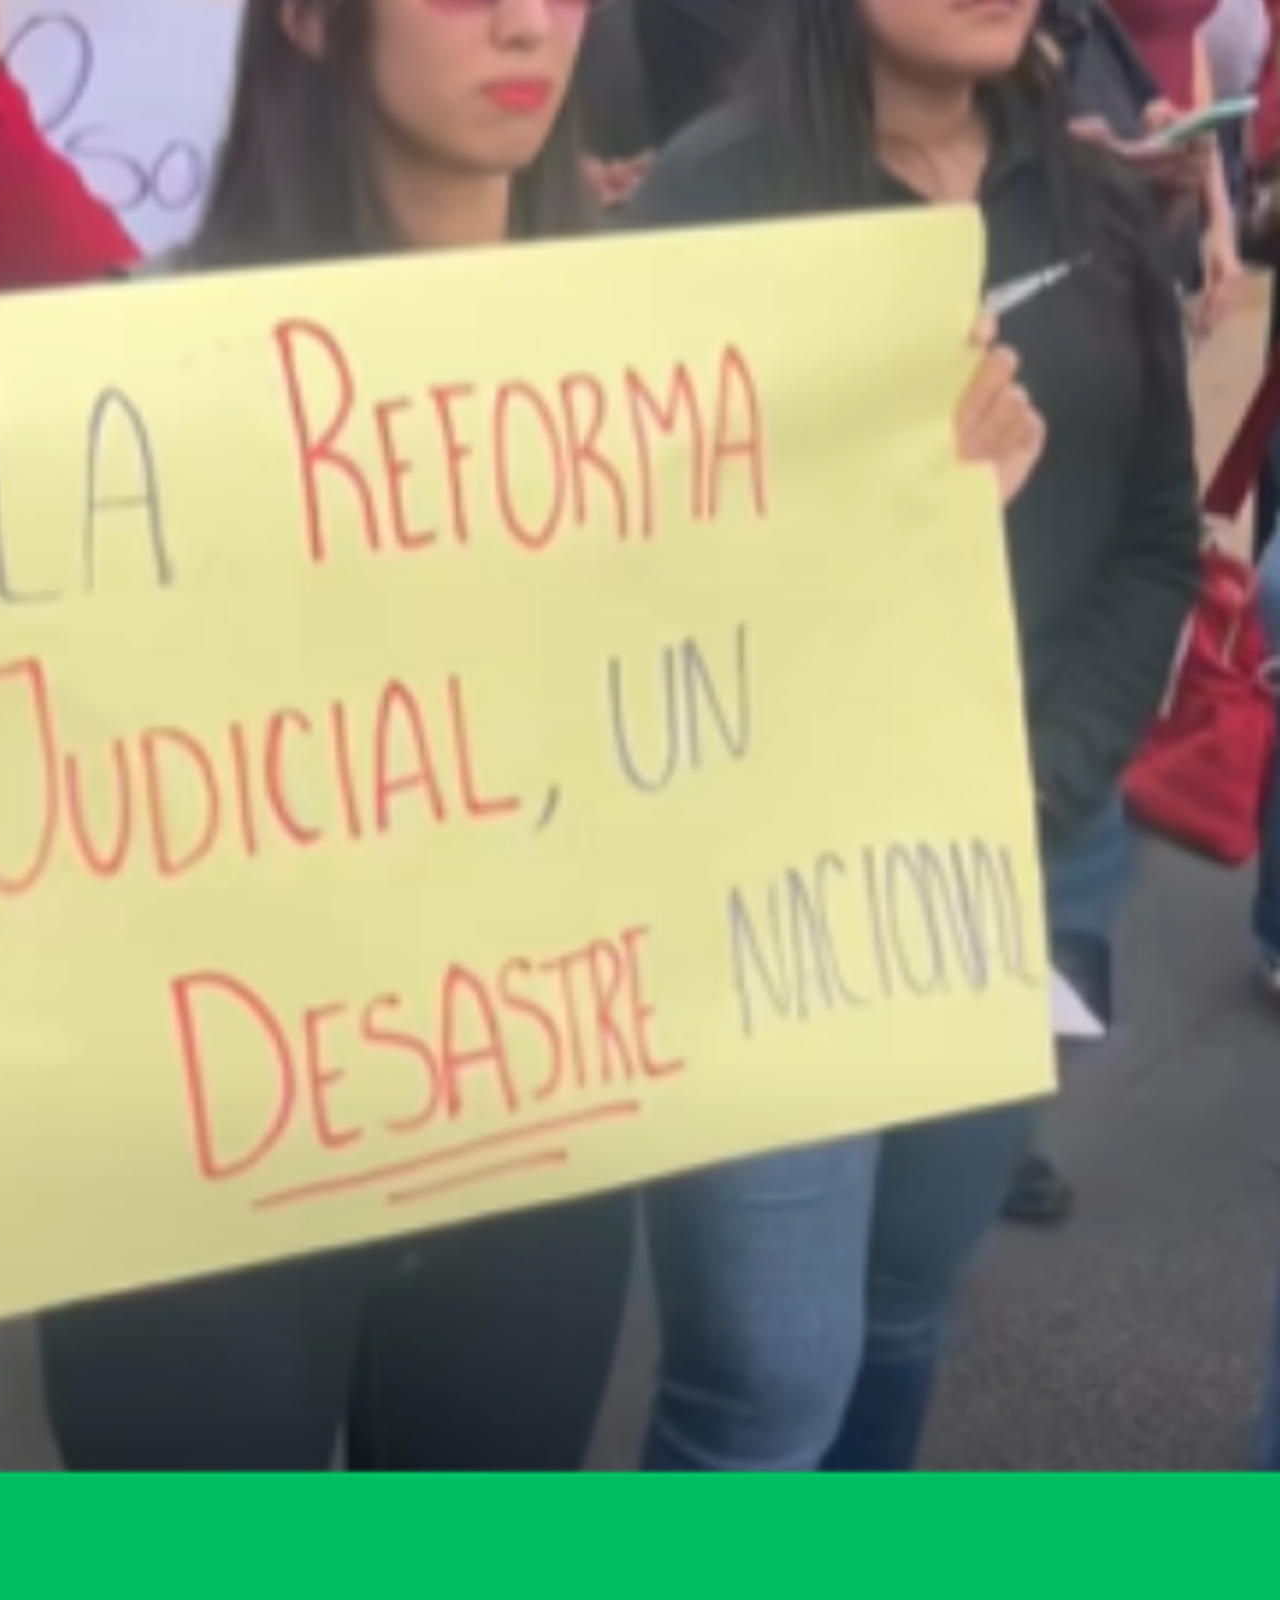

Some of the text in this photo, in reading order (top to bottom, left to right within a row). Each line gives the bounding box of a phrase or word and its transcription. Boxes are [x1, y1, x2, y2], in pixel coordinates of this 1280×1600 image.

[272, 316, 770, 565] REFORMA
[606, 620, 753, 794] UN
[169, 923, 688, 1182] DESASTRE
